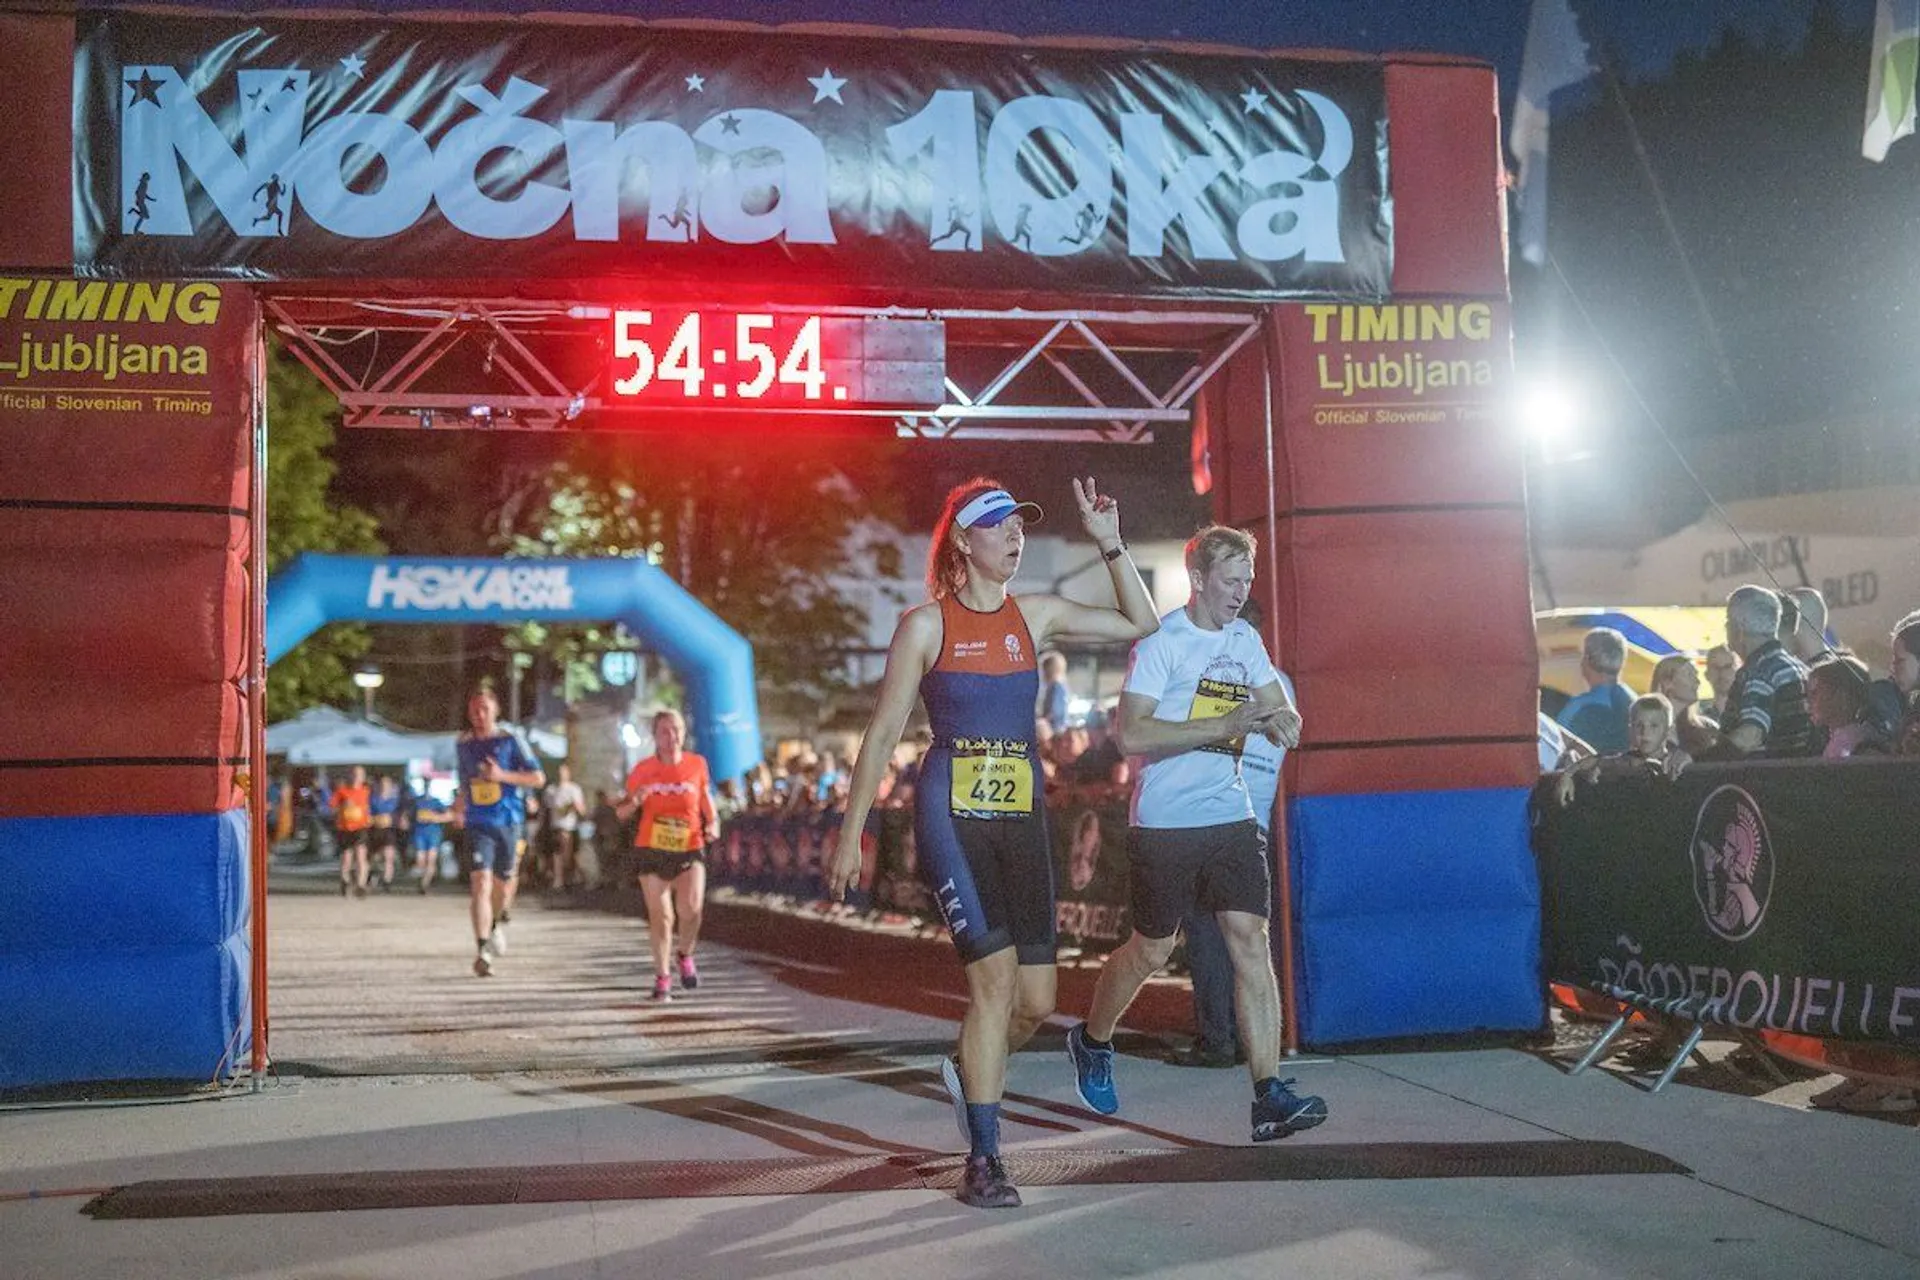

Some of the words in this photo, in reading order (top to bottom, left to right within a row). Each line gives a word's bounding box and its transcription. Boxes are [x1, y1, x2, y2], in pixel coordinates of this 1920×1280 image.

[121, 65, 837, 245] Nočna
[886, 88, 1353, 263] 10ka
[0, 277, 222, 325] TIMING
[1304, 302, 1493, 342] TIMING
[1317, 351, 1493, 396] Ljubljana
[0, 394, 46, 410] ficial
[55, 395, 142, 412] Slovenian
[153, 397, 213, 414] Timing
[1314, 410, 1369, 426] Official
[1375, 409, 1447, 424] Slovenian
[367, 564, 513, 612] HOKA
[972, 763, 1016, 774] KARMEN
[970, 779, 1016, 803] 422
